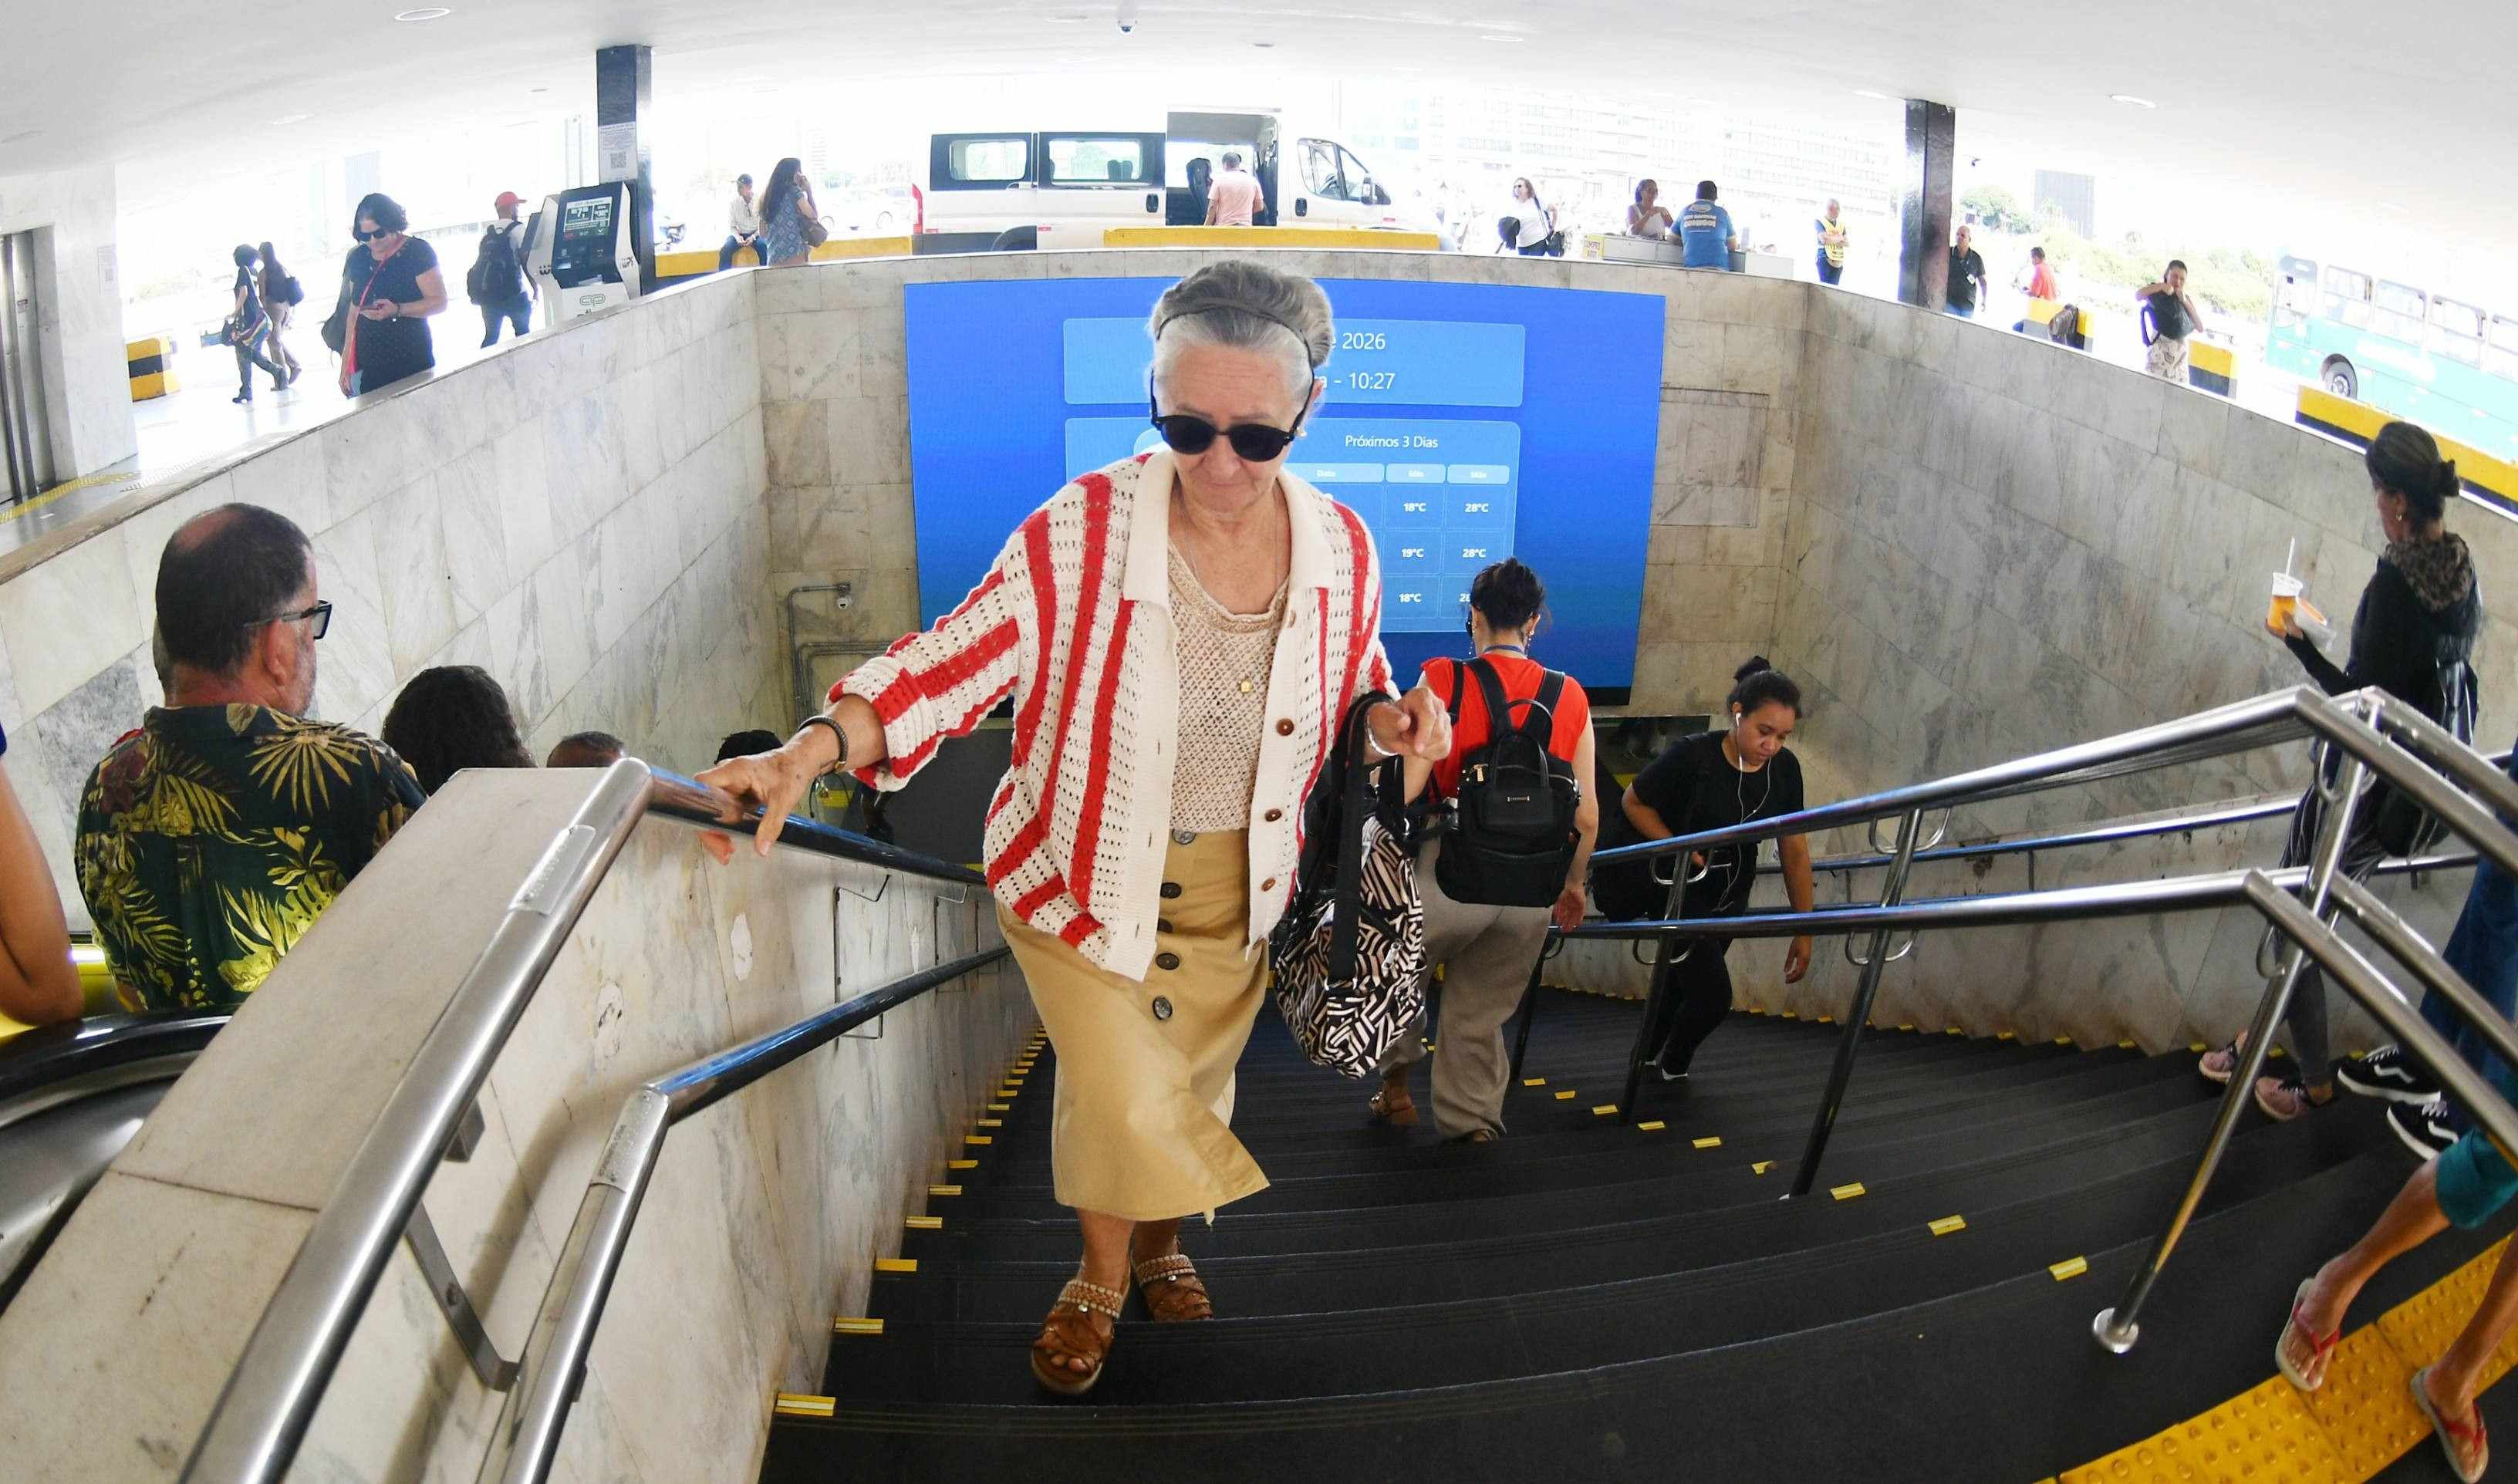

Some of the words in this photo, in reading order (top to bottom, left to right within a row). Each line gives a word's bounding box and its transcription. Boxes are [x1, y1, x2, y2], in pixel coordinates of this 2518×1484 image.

[1342, 332, 1386, 349] 2026
[1348, 373, 1395, 390] 10:27
[1345, 435, 1399, 447] Próximos
[1402, 436, 1409, 447] 3
[1413, 437, 1438, 448] Dias
